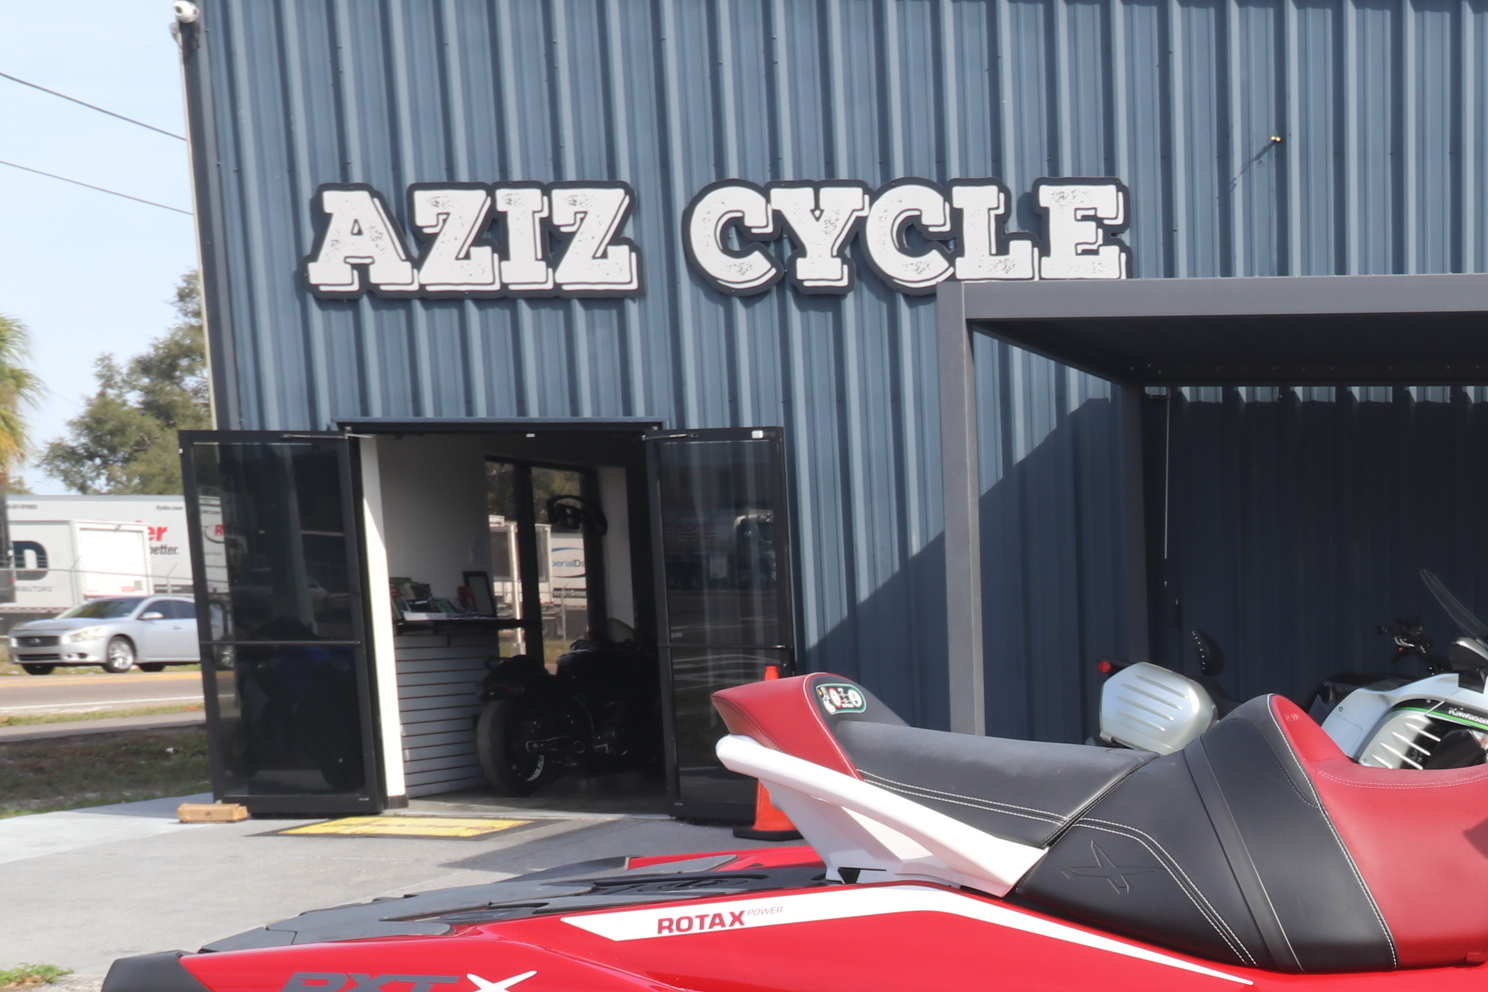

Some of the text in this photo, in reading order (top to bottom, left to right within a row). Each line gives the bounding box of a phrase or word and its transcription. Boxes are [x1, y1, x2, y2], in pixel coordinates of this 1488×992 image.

[304, 181, 1129, 294] AZIZ CYCLE
[657, 906, 783, 935] ROTAX POWER
